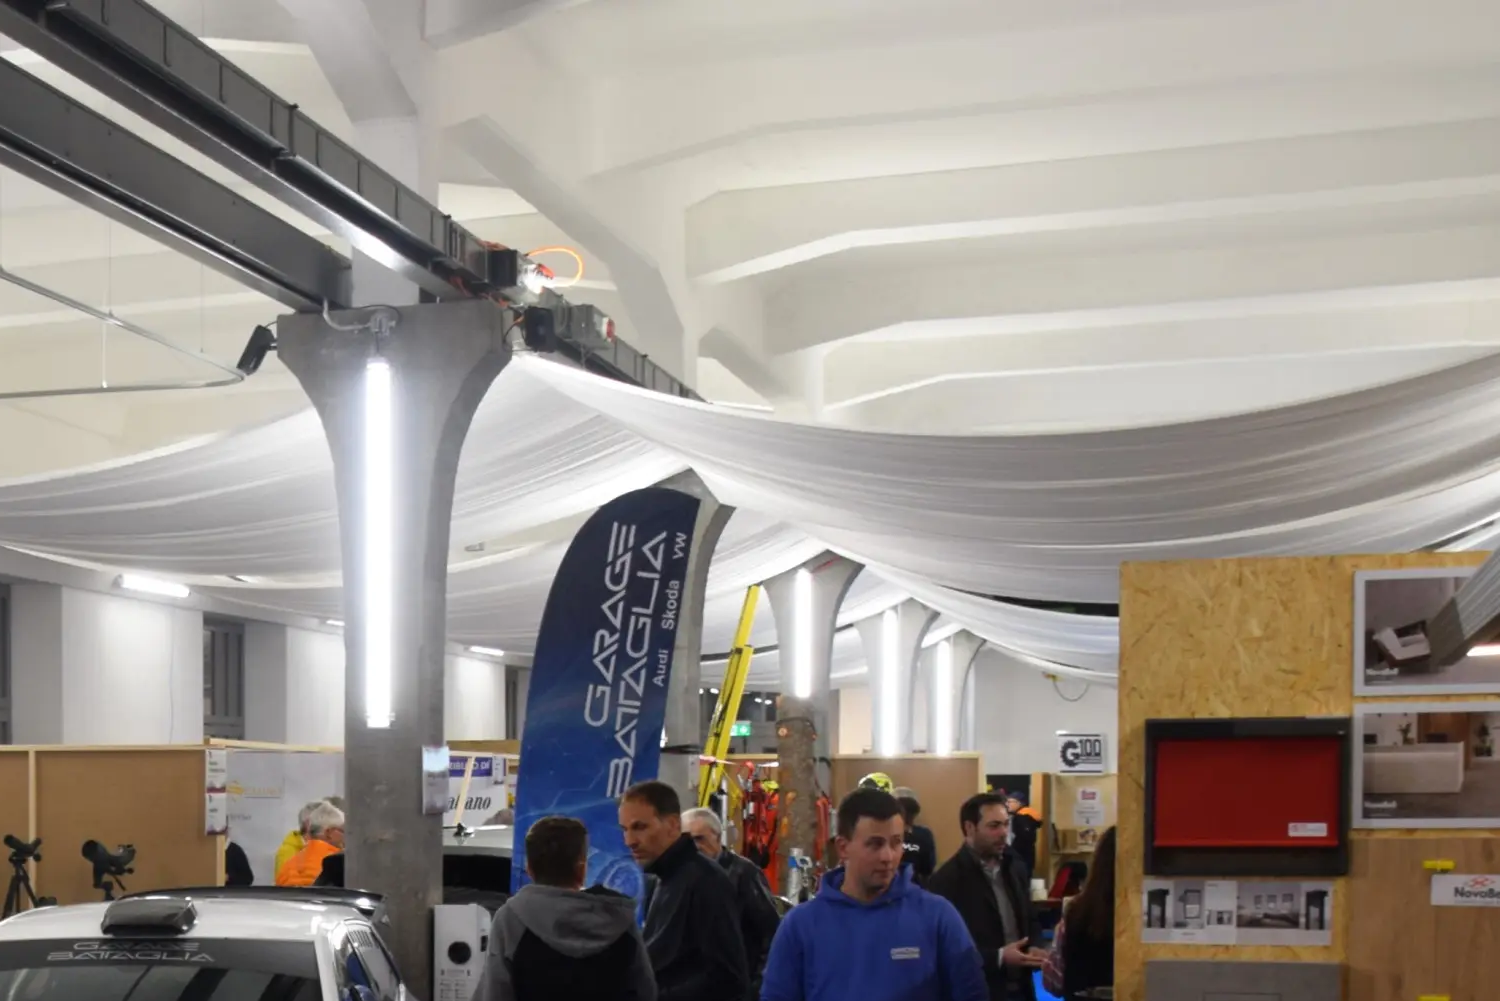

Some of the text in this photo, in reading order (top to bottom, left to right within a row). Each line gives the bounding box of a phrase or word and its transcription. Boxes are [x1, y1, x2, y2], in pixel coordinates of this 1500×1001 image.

[584, 521, 637, 728] GARAGE
[660, 579, 681, 631] Skoda
[606, 530, 669, 799] BATTAGLIA
[653, 648, 670, 687] Audi
[47, 951, 215, 962] BATTAGLIA
